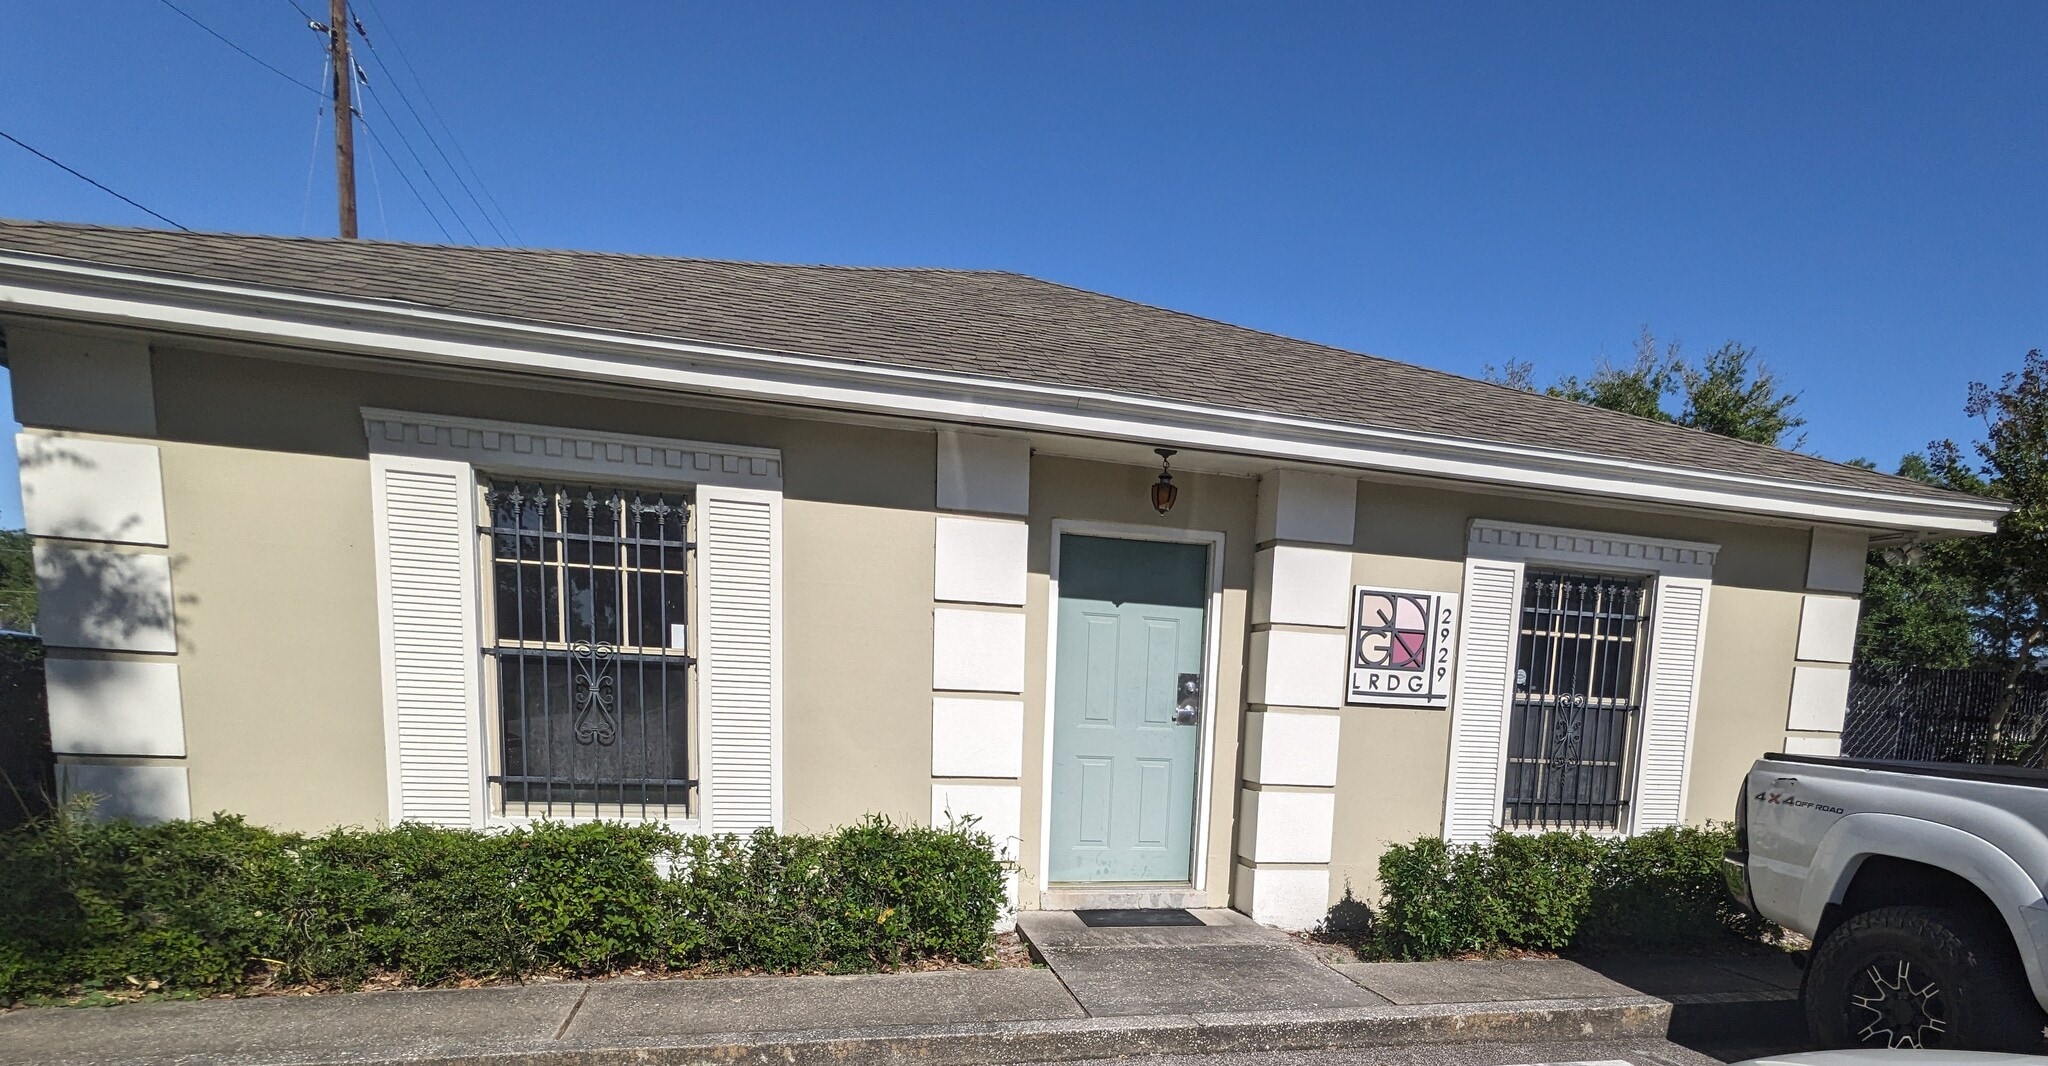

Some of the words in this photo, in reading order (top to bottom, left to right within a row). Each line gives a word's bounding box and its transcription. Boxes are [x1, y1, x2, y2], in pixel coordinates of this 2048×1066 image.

[1437, 608, 1452, 683] 2929
[1352, 672, 1424, 693] LRDG
[1795, 800, 1815, 809] OFF
[1815, 804, 1845, 815] ROAD
